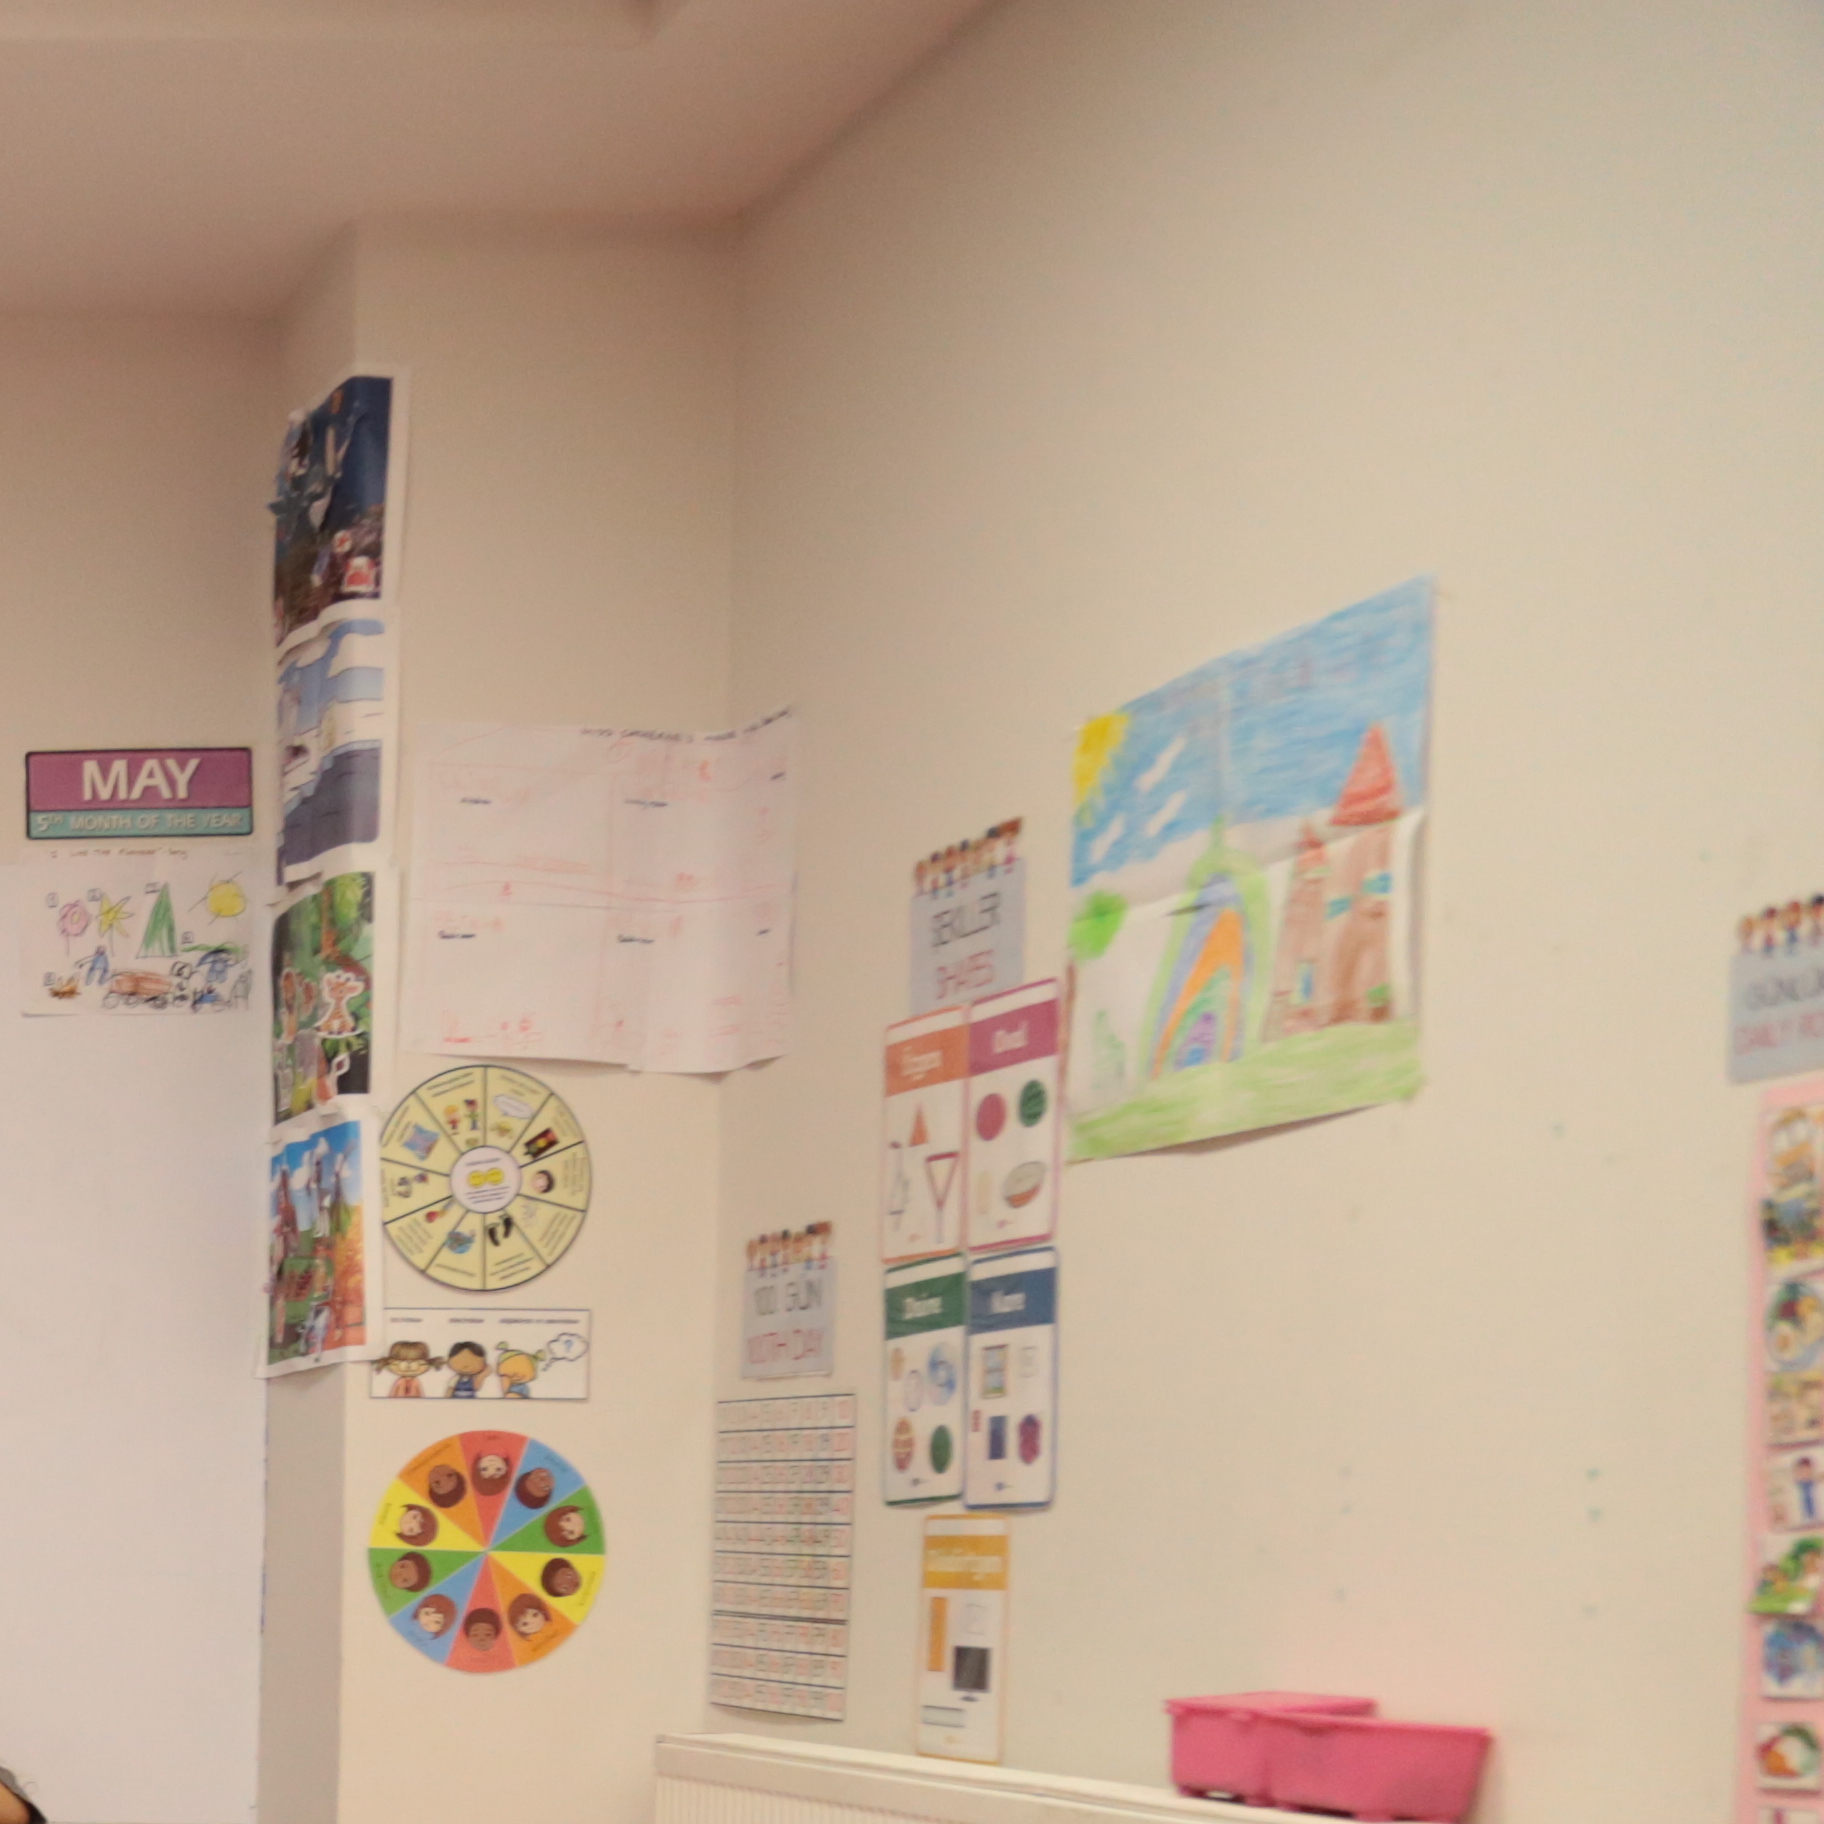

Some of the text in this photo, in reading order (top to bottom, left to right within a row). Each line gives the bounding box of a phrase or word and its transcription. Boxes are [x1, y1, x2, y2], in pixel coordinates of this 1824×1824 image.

[81, 758, 201, 801] MAY
[69, 814, 132, 831] MONTH
[136, 813, 160, 830] OF
[164, 813, 196, 829] THE
[201, 812, 243, 829] YEAR
